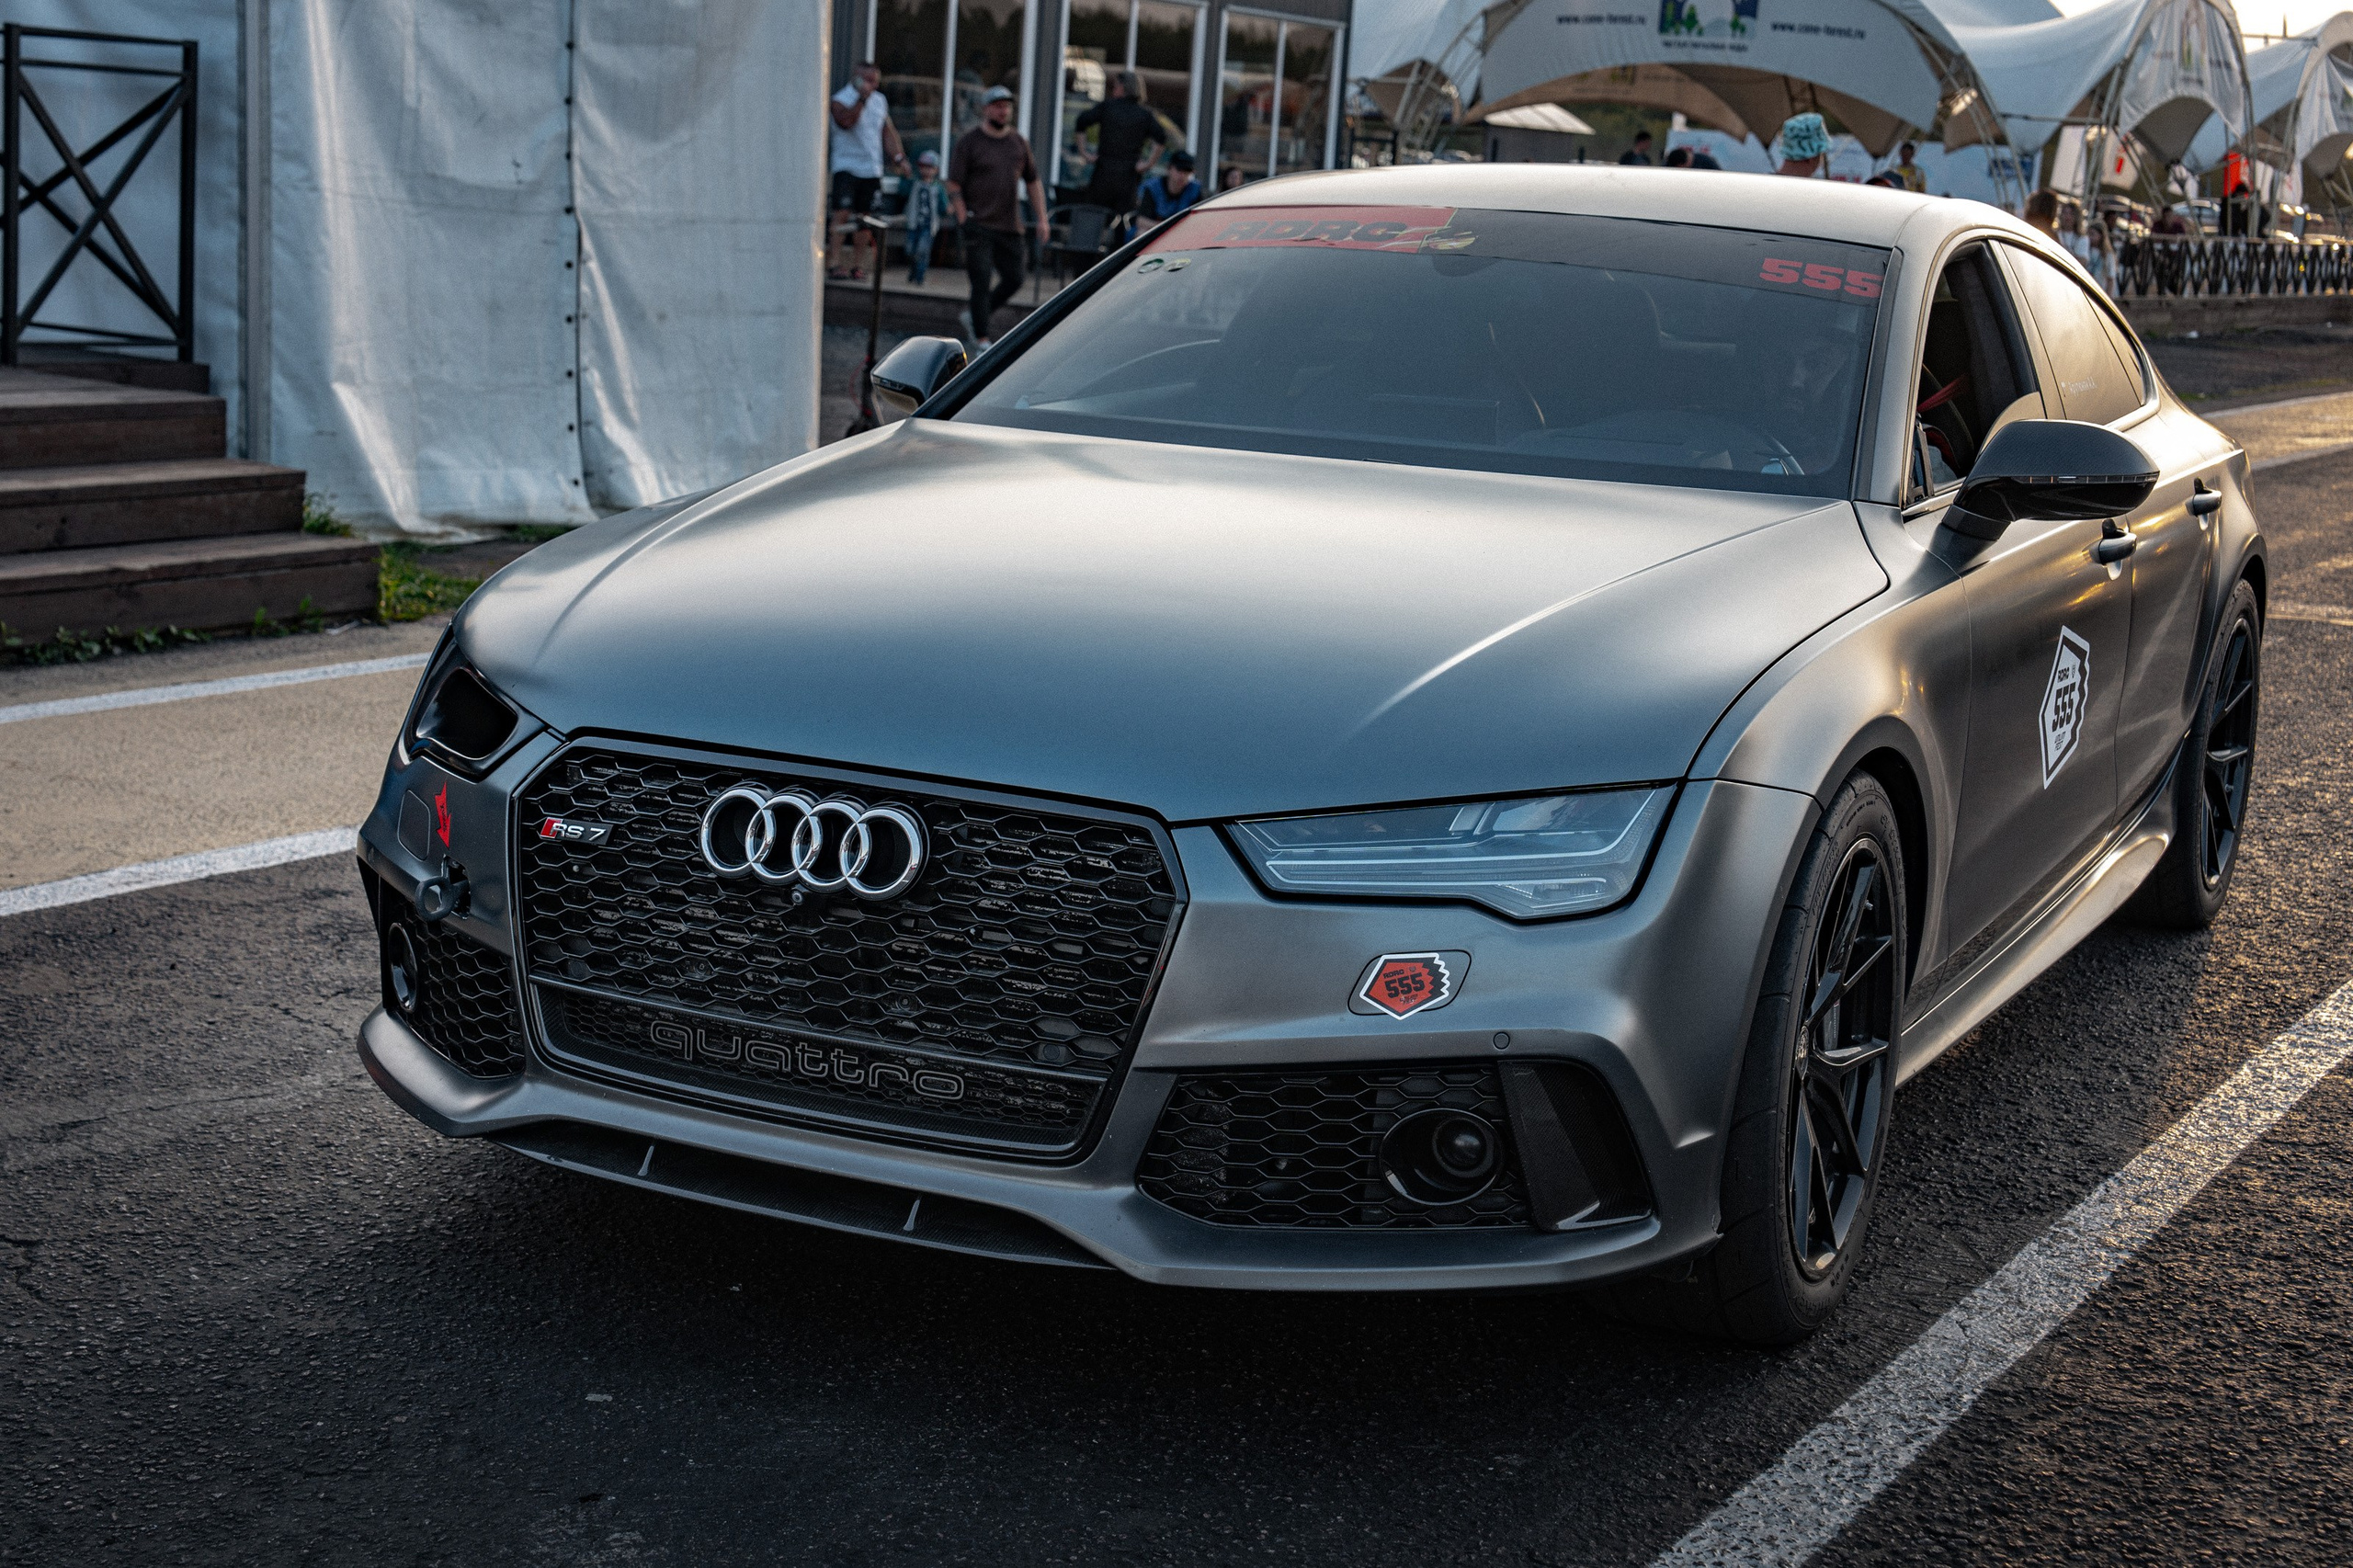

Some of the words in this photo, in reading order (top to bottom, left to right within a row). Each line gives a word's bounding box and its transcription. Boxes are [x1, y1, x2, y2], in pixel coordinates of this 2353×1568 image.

[1759, 258, 1884, 298] 555
[2052, 682, 2075, 733] 555
[1385, 972, 1425, 998] 555
[650, 1020, 964, 1100] quattro
